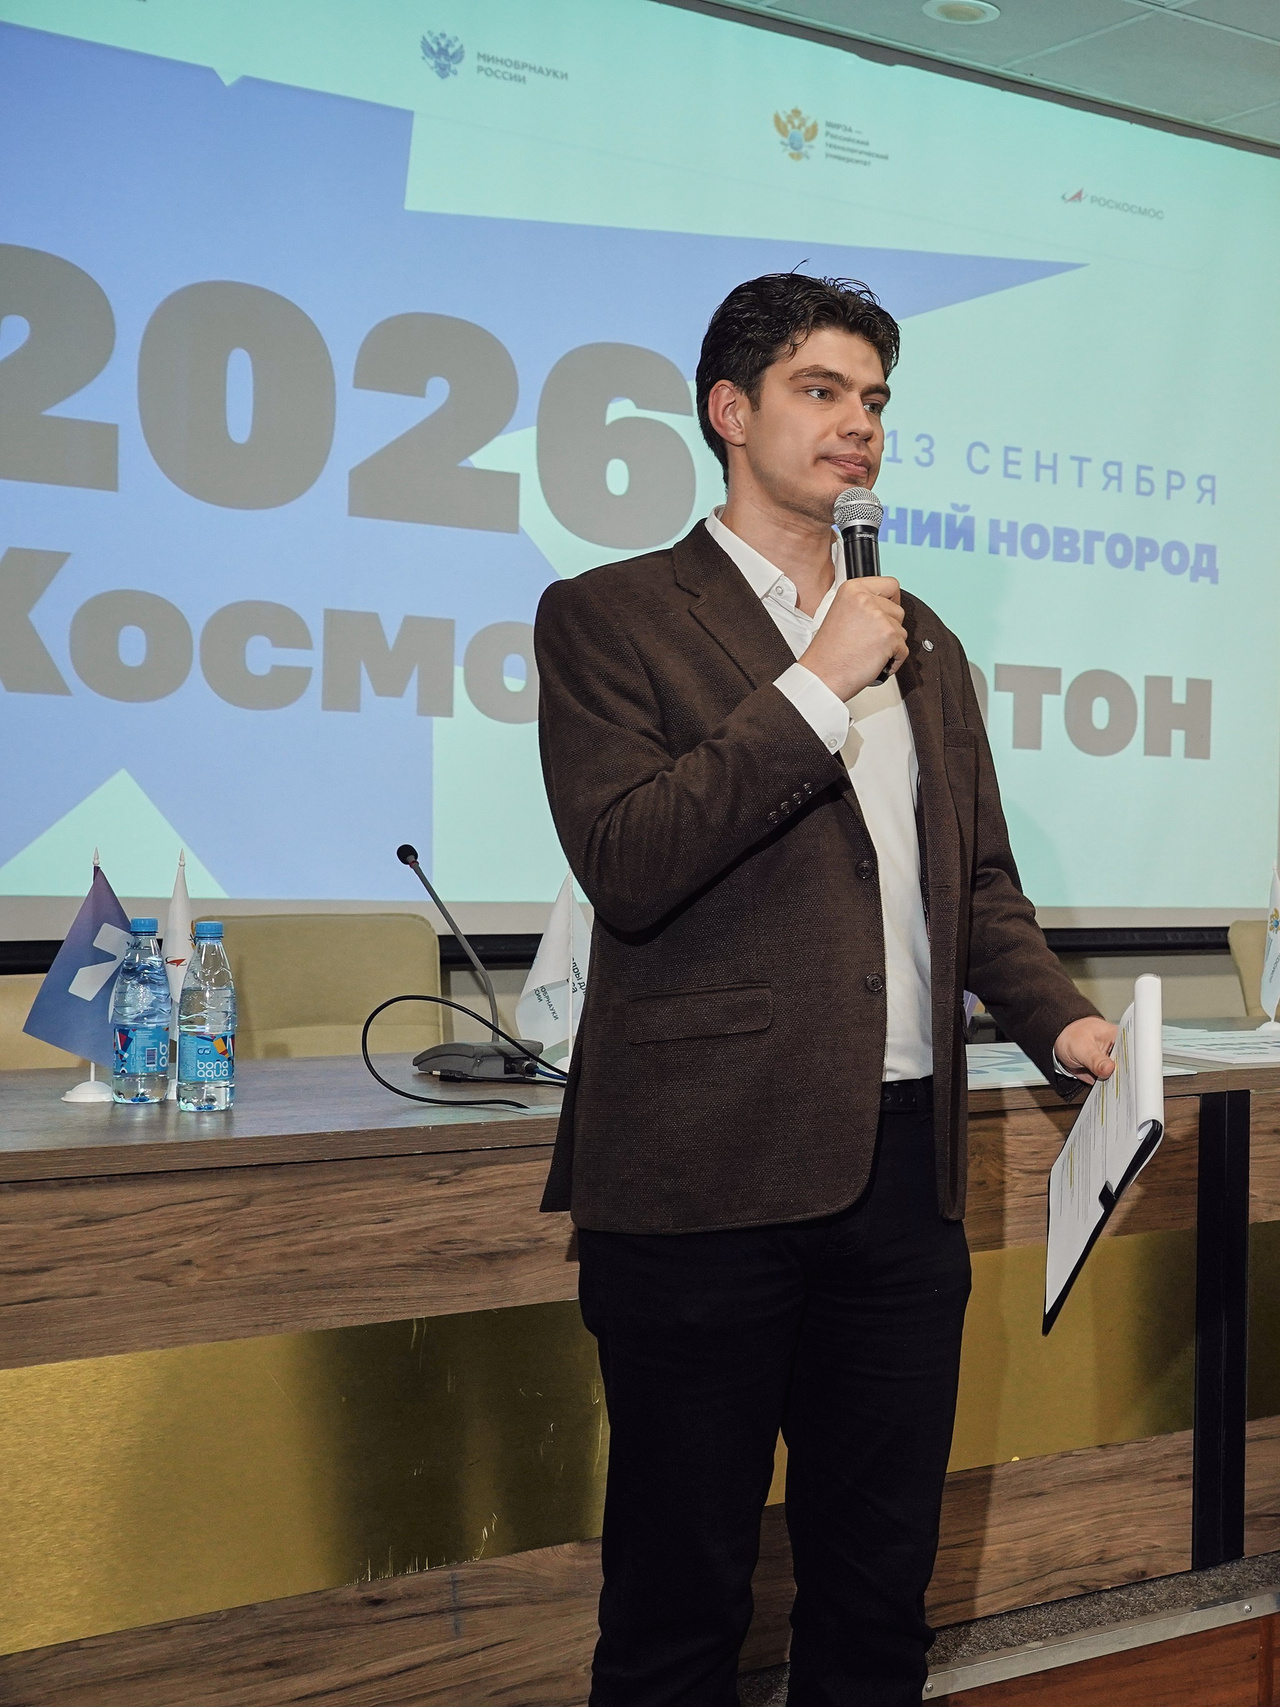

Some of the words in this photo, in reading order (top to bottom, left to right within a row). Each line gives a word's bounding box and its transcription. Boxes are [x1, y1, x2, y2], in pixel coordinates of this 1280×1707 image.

[476, 65, 526, 84] РОССИИ
[477, 51, 569, 81] МИНОБРНАУКИ
[1091, 195, 1164, 220] РОСКОСМОС
[0, 243, 697, 551] 2026
[966, 440, 1218, 506] СЕНТЯБРЯ
[988, 518, 1220, 585] НОВГОРОД
